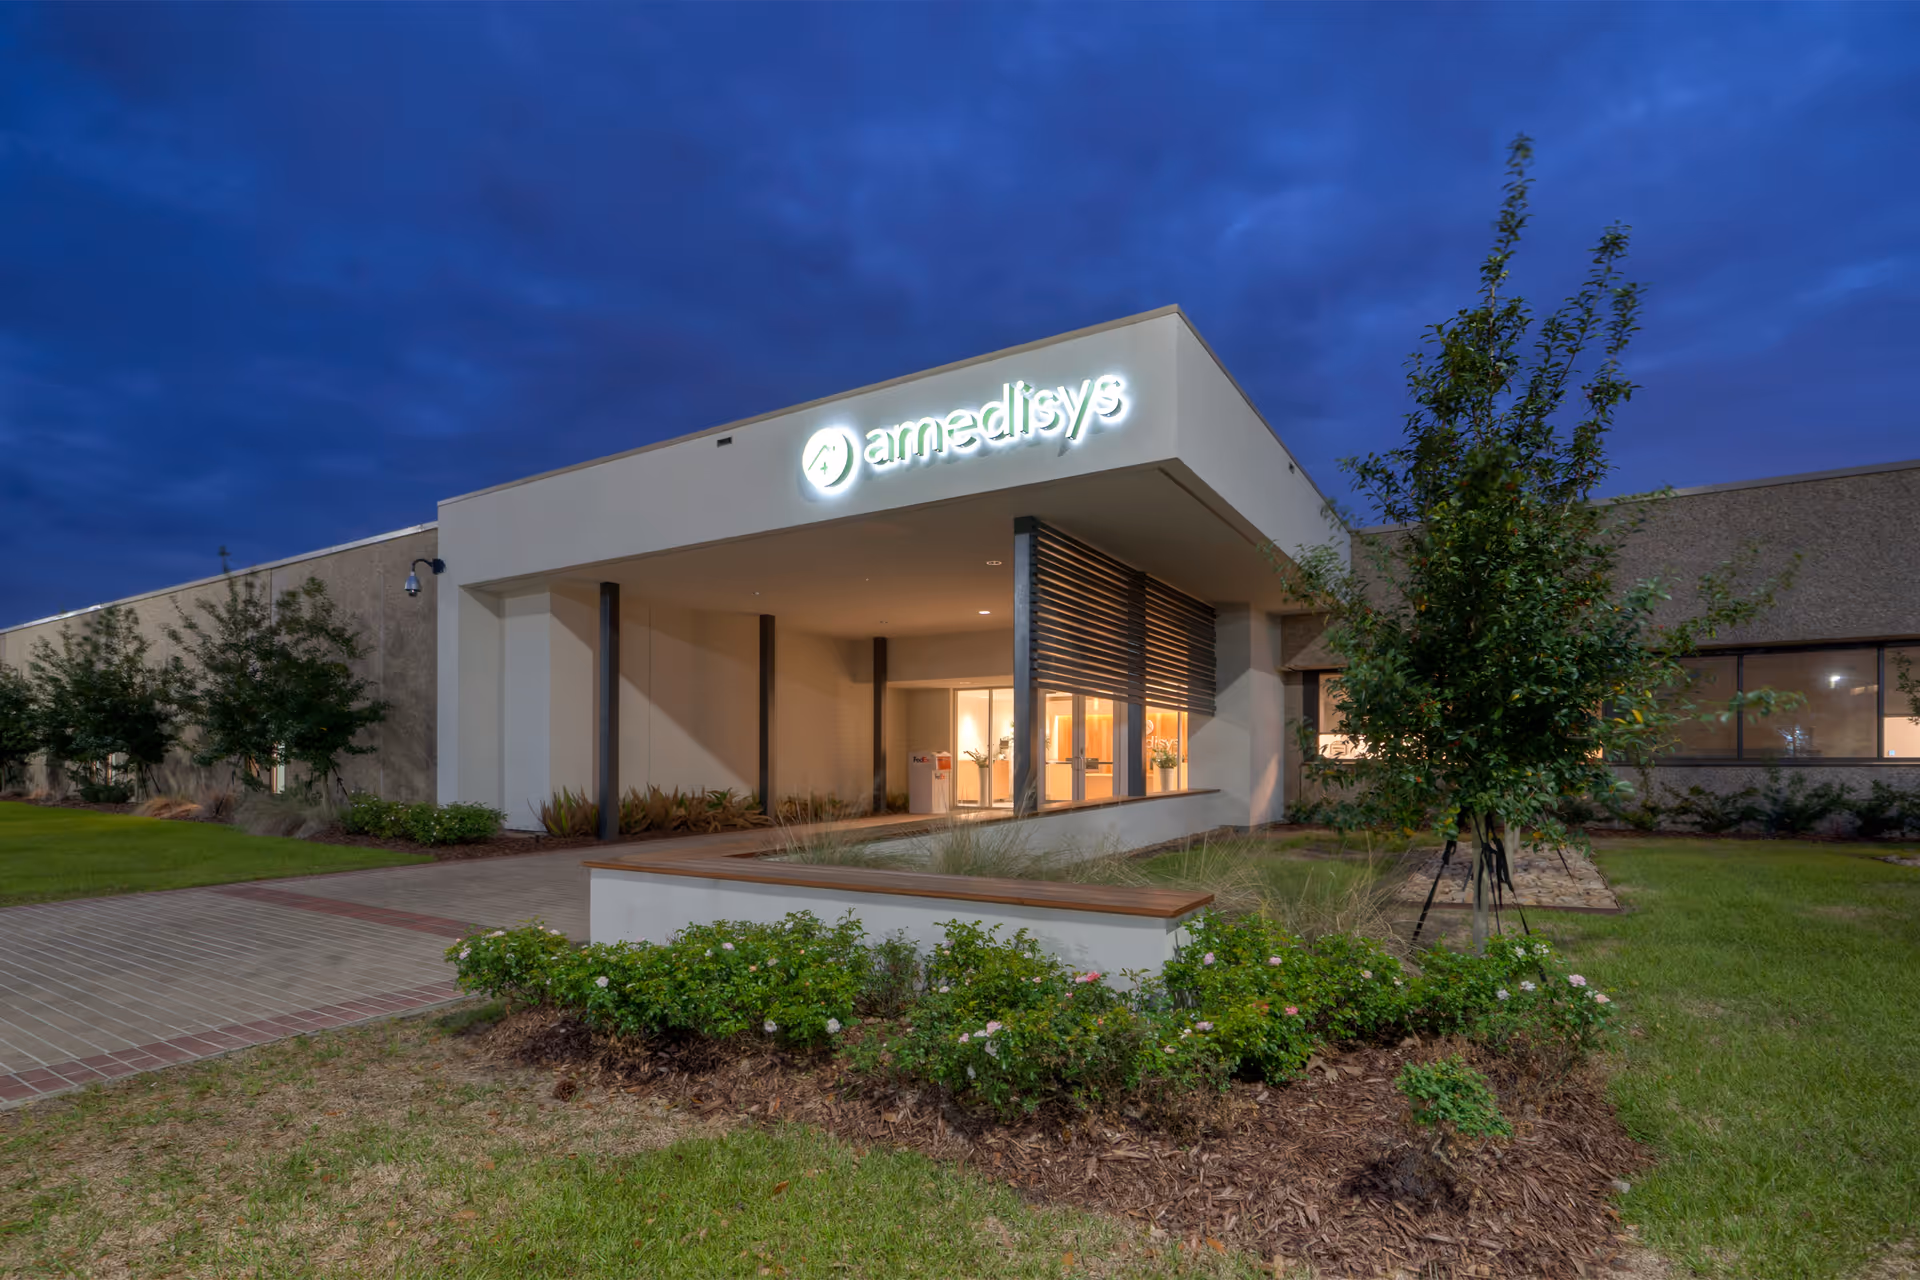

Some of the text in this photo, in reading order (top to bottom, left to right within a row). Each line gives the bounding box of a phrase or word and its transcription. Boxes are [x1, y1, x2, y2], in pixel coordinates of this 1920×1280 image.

[864, 374, 1123, 466] amedisys
[1145, 735, 1178, 751] disys
[912, 755, 930, 764] FedE
